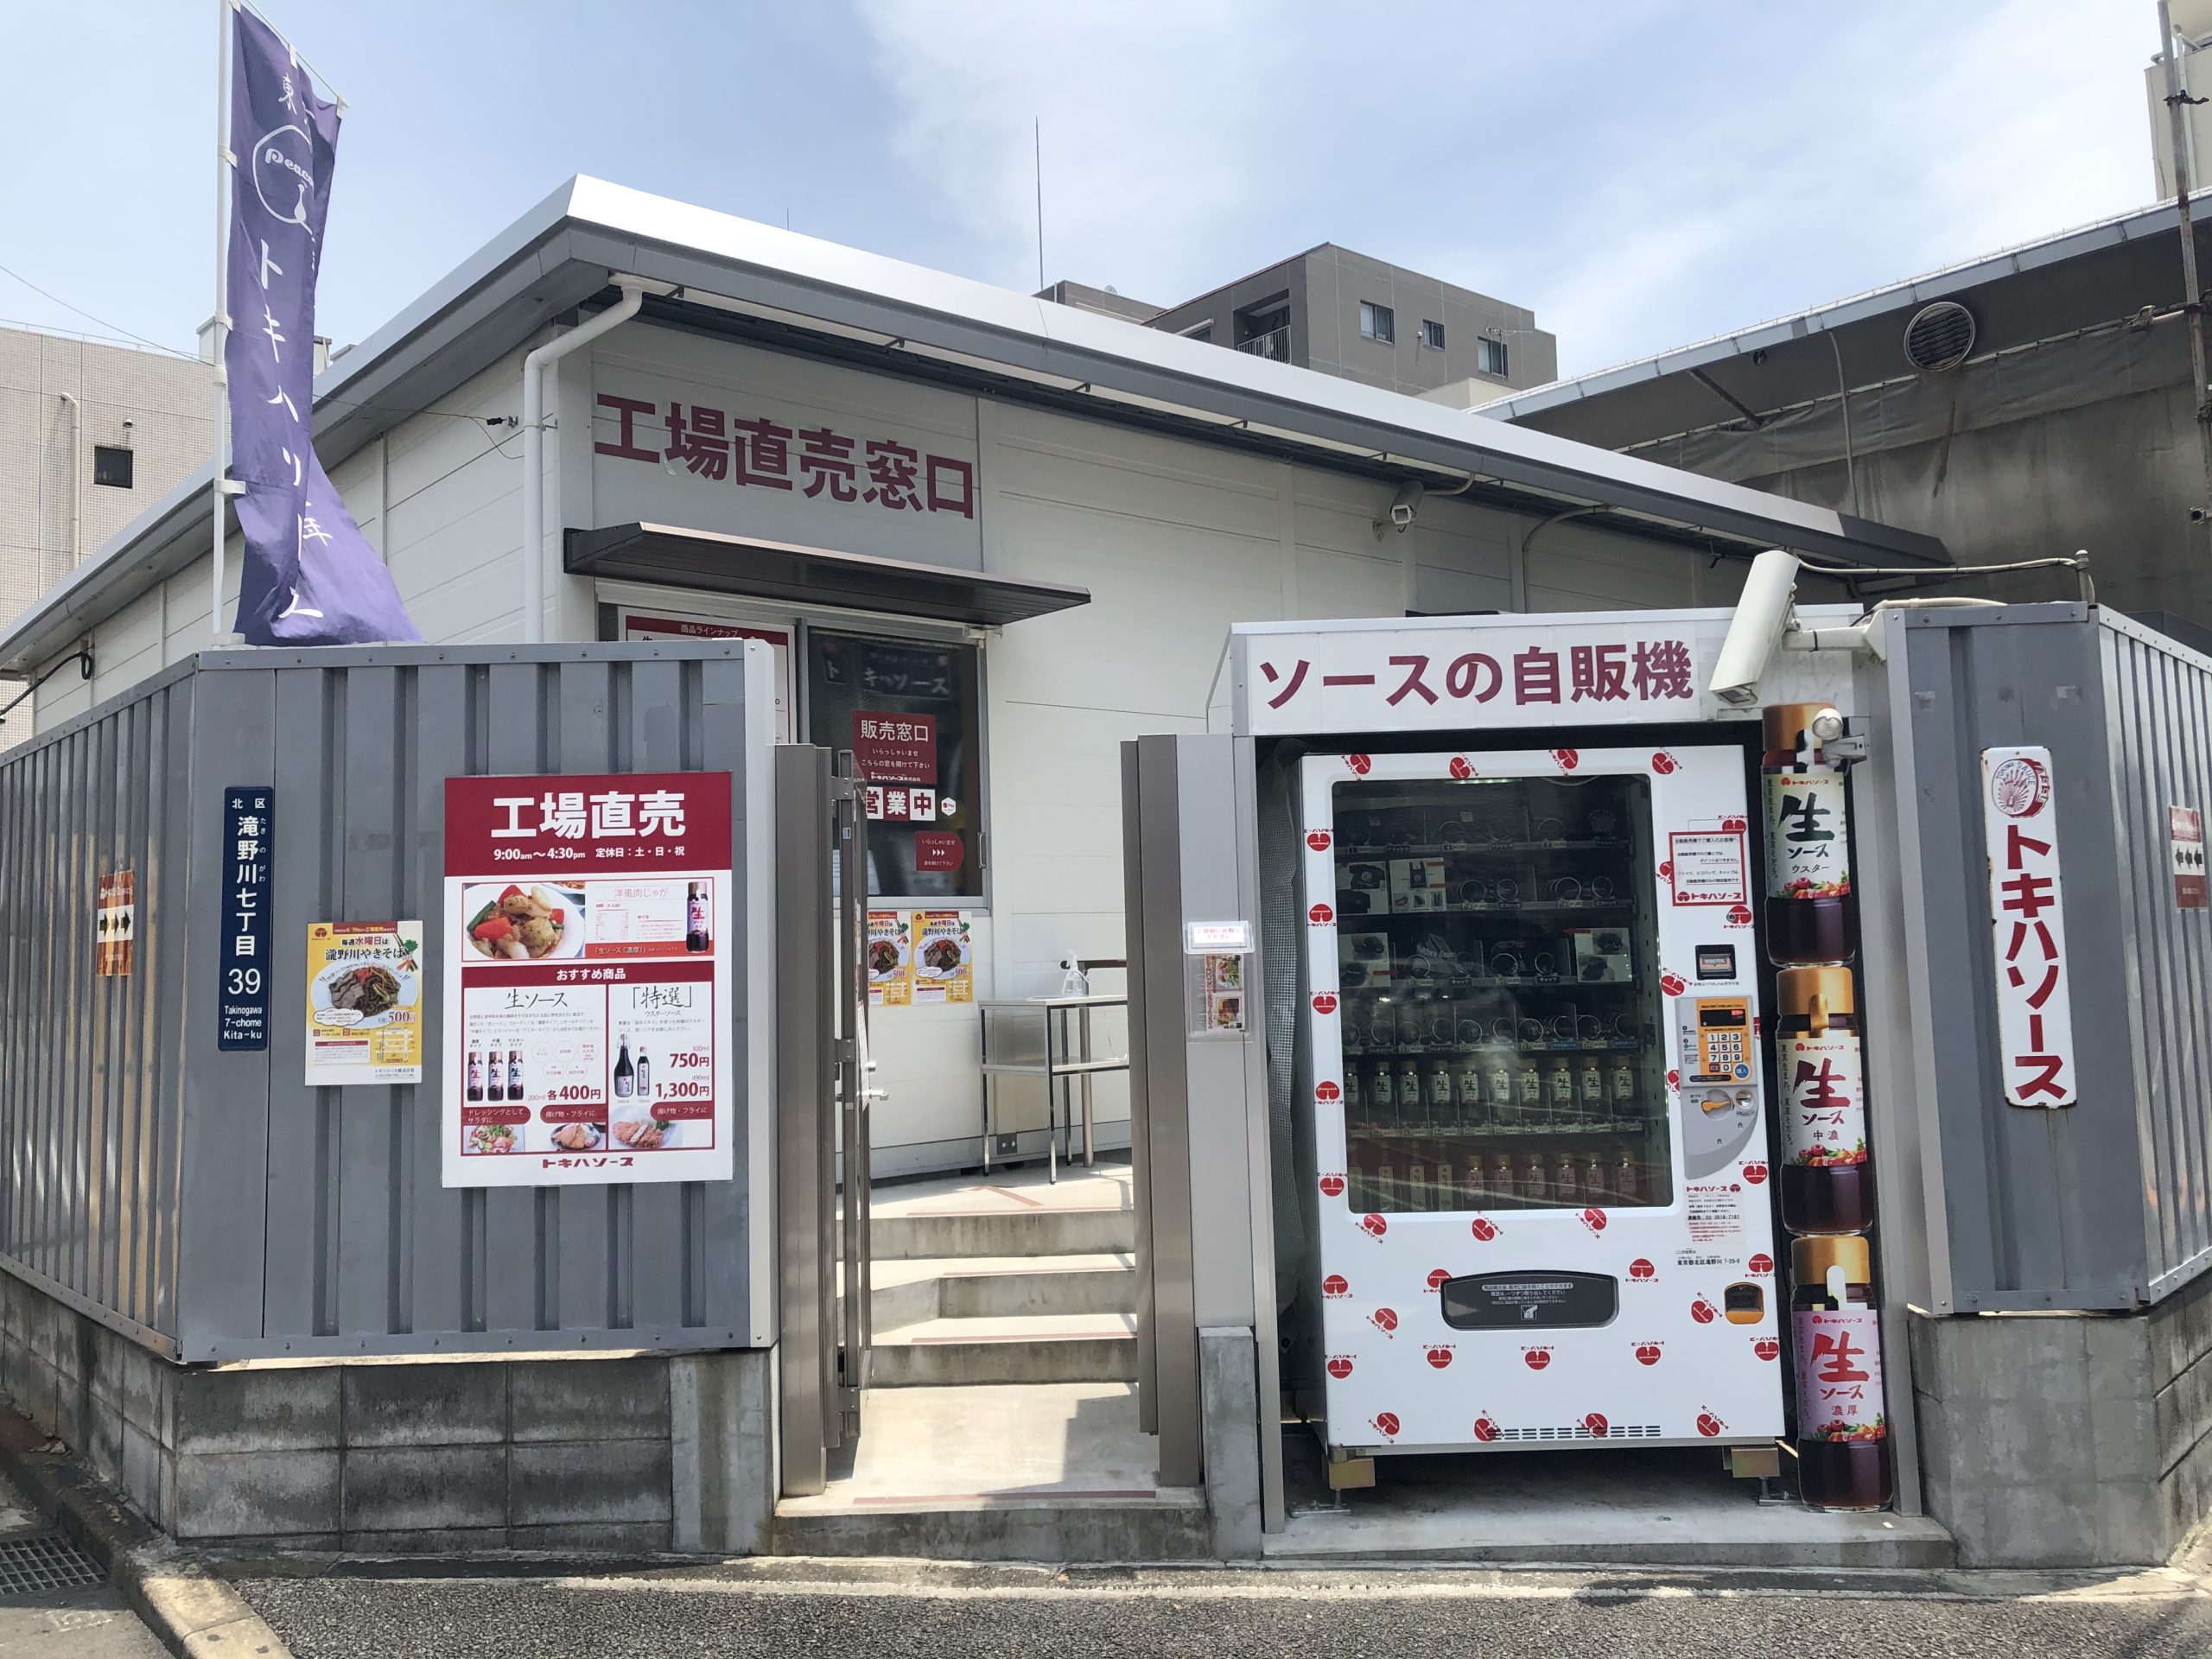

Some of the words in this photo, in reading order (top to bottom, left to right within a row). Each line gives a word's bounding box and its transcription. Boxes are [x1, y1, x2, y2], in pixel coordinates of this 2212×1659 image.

[594, 393, 974, 519] 工場直売窓口
[680, 624, 739, 637] 商品ラインナップ
[1260, 640, 1694, 710] ソースの自販機
[861, 719, 929, 742] 販売窓口
[872, 748, 918, 757] いらっしゃいませ
[861, 760, 931, 769] こちらの窓を開けて下さい
[2018, 761, 2036, 785] SAUCE
[232, 798, 266, 809] 北区
[867, 791, 931, 816] 営業中
[491, 790, 686, 839] 工場直売
[1777, 791, 1835, 842] 生
[258, 817, 267, 881] たきのがわ
[1788, 842, 1829, 859] ソース
[1791, 864, 1830, 874] ウスター
[235, 816, 259, 956] 滝野川七丁目
[613, 887, 669, 898] 洋風肉じゃが
[692, 906, 705, 919] 生
[341, 937, 388, 945] 毎週水曜日は
[2000, 824, 2068, 1100] トキハソース
[228, 968, 261, 995] 39
[556, 968, 626, 981] おすすめ商品
[504, 988, 569, 1009] 生ソース
[632, 985, 692, 1009] 「特選」
[224, 1005, 263, 1017] Takinogawa
[225, 1018, 262, 1027] 7-chome
[224, 1030, 262, 1039] Kita-ku
[670, 1052, 709, 1068] 750円
[471, 1069, 480, 1078] 生
[491, 1069, 500, 1078] 生
[511, 1068, 521, 1077] 生
[1793, 1058, 1851, 1108] 生
[547, 1084, 601, 1101] 各400円
[655, 1082, 709, 1100] 1,300円
[468, 1108, 524, 1116] ドレッシングとして
[545, 1109, 595, 1118] 揚げ物・フライに
[658, 1106, 708, 1116] 揚げ物・フライに
[1802, 1109, 1845, 1125] ソース
[1813, 1130, 1840, 1141] 中濃
[542, 1157, 634, 1168] トキハソース
[1810, 1331, 1870, 1382] 生
[1820, 1384, 1864, 1401] ソース
[1831, 1405, 1858, 1416] 濃厚
